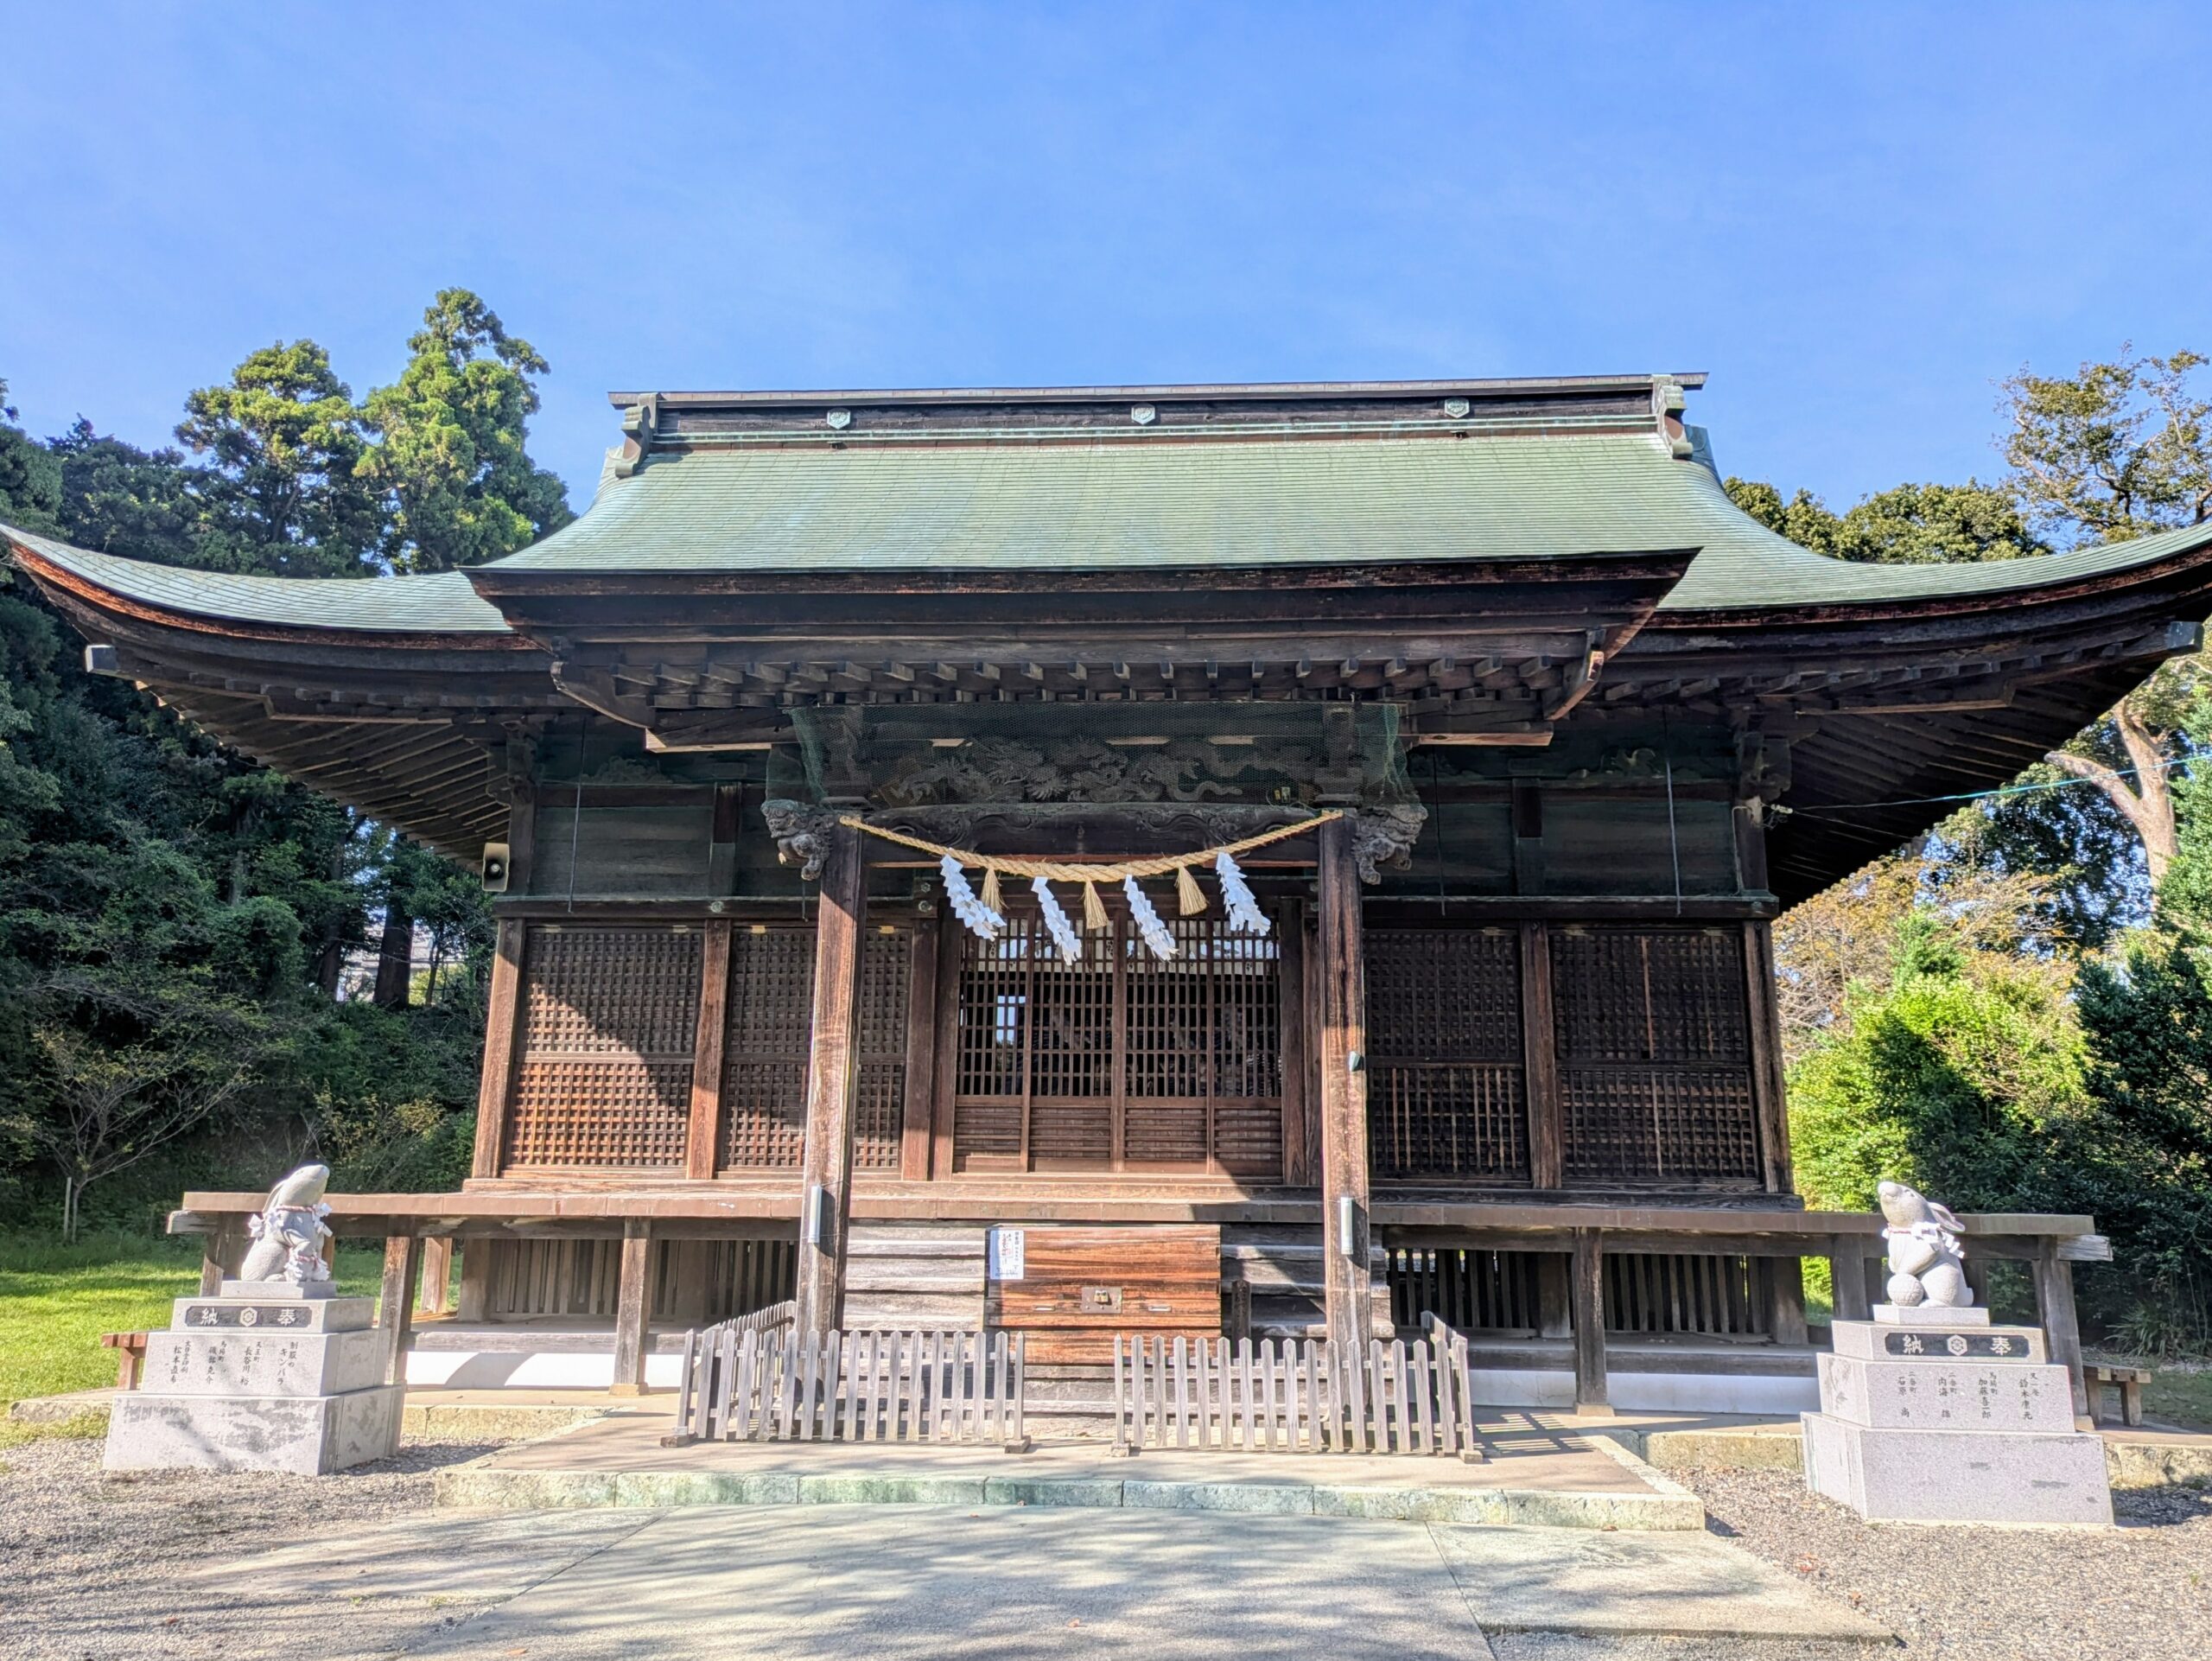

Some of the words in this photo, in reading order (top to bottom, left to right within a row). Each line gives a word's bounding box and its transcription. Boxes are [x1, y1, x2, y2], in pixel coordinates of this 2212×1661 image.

[200, 1307, 219, 1326] 納
[277, 1308, 296, 1327] 奉
[1902, 1334, 1925, 1355] 納
[1989, 1336, 2012, 1356] 奉
